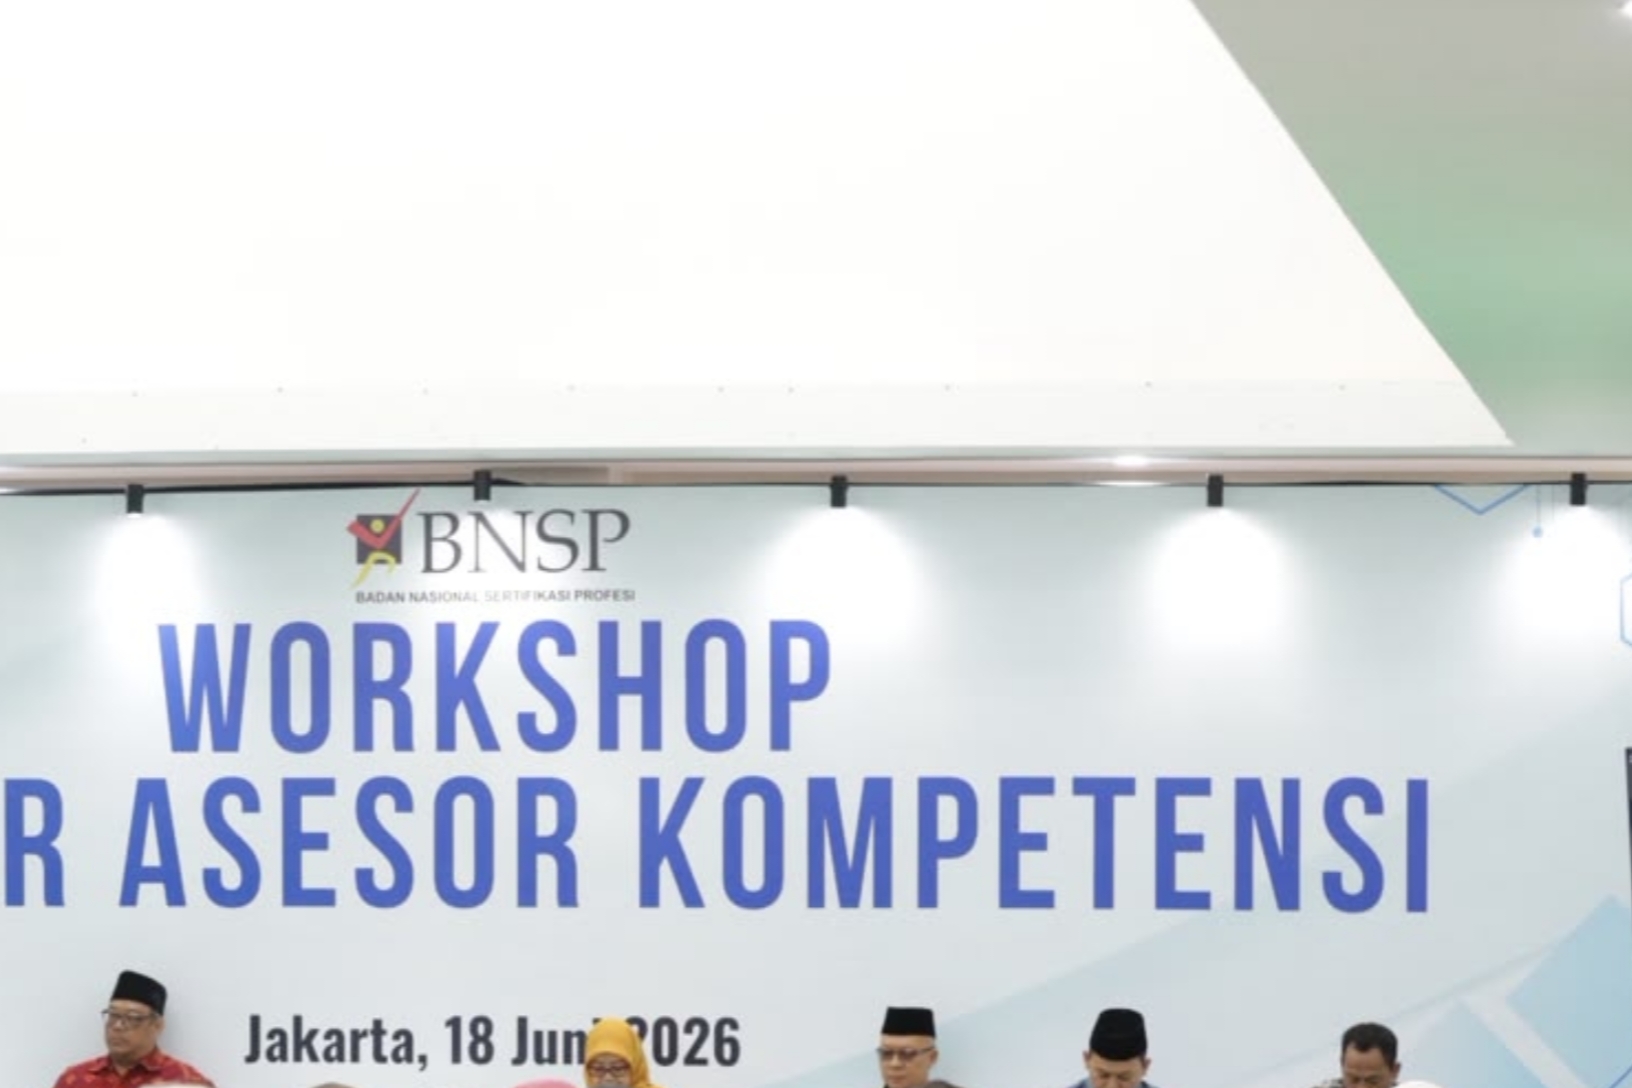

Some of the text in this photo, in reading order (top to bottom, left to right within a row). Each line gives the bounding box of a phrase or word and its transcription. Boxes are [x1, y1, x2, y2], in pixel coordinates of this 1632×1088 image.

[417, 508, 631, 573] BNSP
[355, 589, 636, 604] BADAN NASIONAL SERTIFIKASI PROFESI
[159, 619, 831, 754] WORKSHOP
[120, 776, 579, 909] ASESOR
[641, 776, 1430, 913] KOMPETENSI
[244, 1014, 428, 1071] Jakarta,
[444, 1015, 495, 1065] 18
[511, 1016, 601, 1066] Jun
